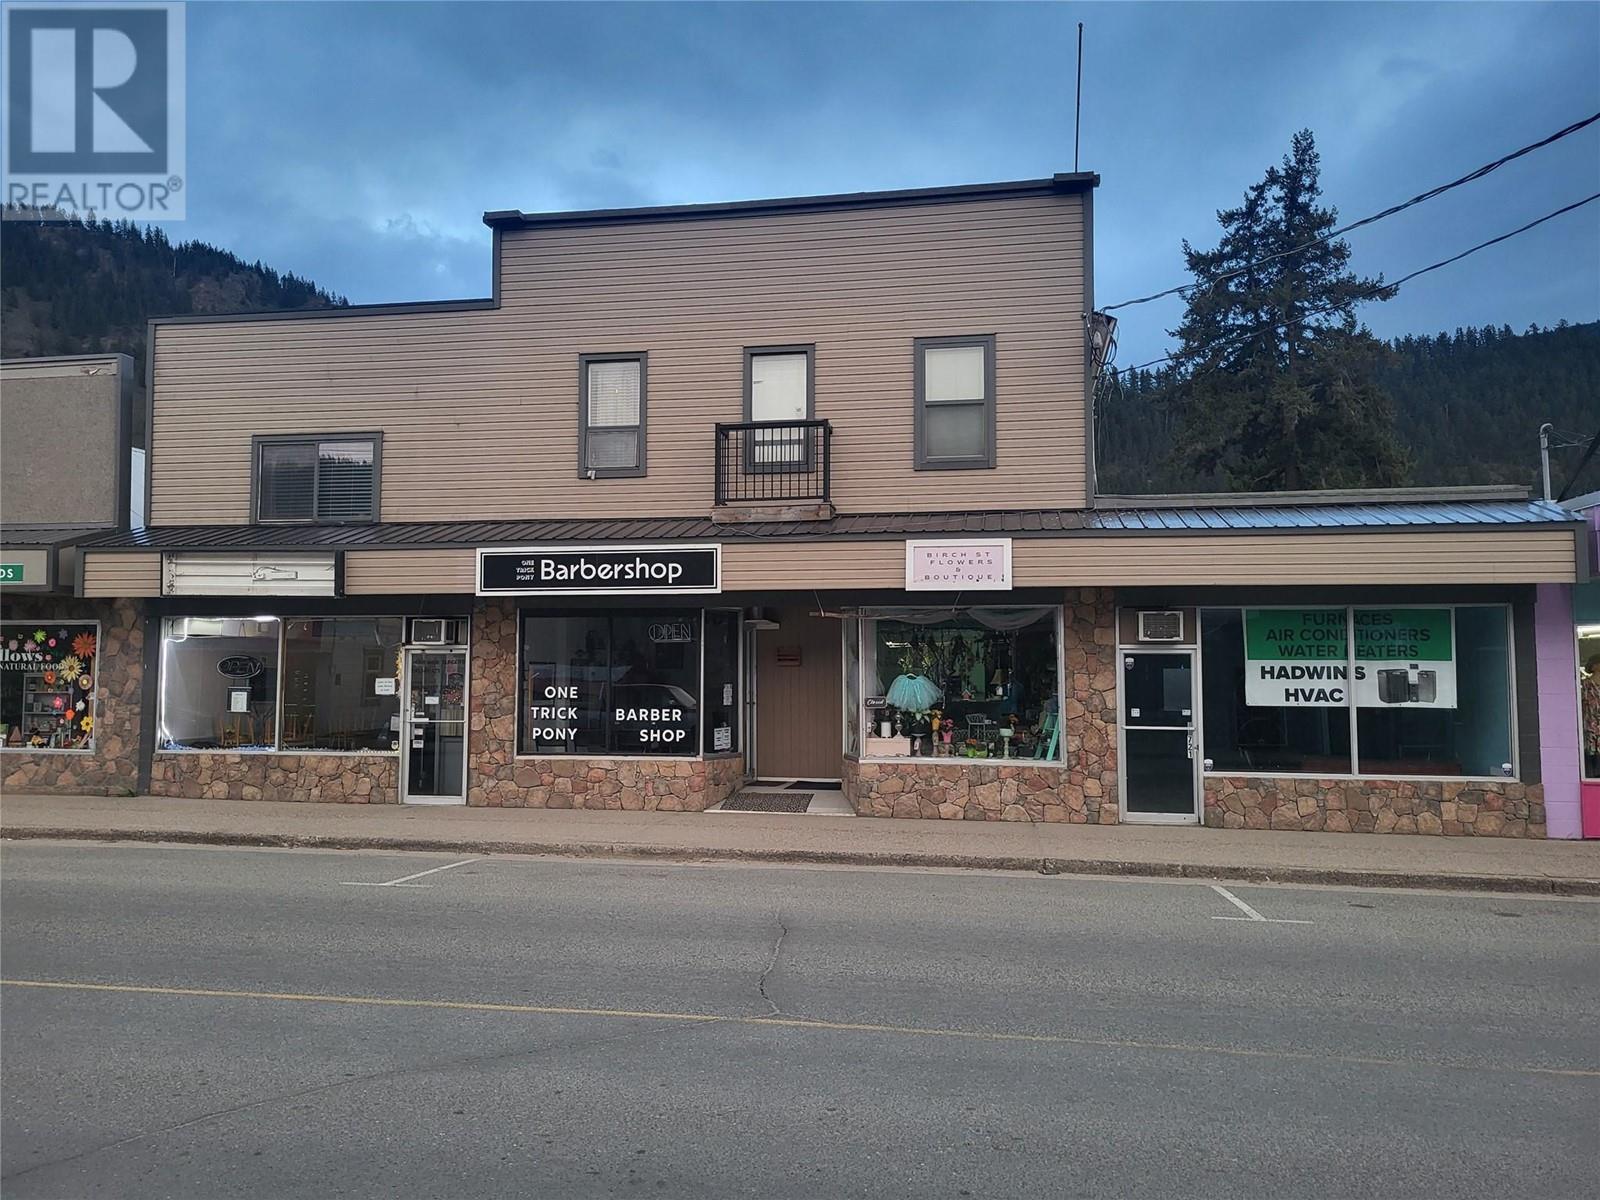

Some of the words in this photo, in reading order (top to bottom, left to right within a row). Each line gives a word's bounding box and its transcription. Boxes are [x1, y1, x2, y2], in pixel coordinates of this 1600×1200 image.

[540, 557, 683, 584] Barbershop
[648, 622, 691, 642] OPEN
[1265, 628, 1295, 641] AIR
[1299, 628, 1431, 642] CONDTIONERS
[1277, 645, 1338, 658] WATER
[219, 660, 261, 674] OPEN
[544, 686, 579, 699] ONE
[1284, 687, 1345, 703] HVAC
[530, 706, 579, 720] TRICK
[615, 708, 682, 721] BARBER
[532, 727, 579, 740] PONY
[639, 729, 687, 742] SHOP
